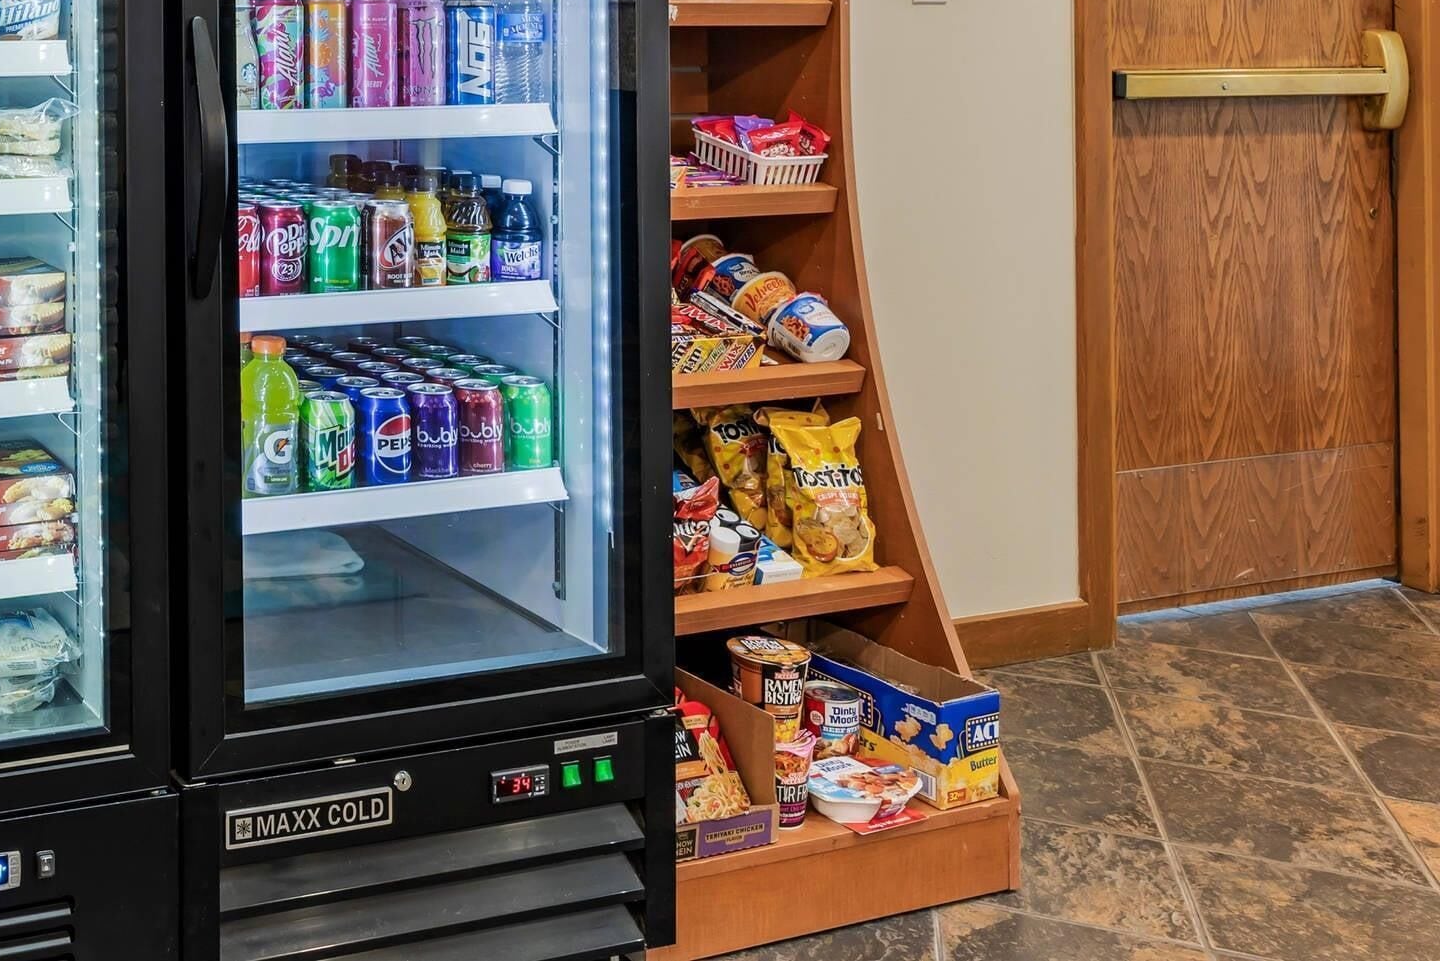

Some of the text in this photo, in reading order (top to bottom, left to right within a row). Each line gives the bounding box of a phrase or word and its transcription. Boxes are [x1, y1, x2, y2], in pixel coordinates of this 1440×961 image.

[459, 9, 492, 98] NOS
[504, 248, 539, 264] Welch's
[281, 262, 294, 275] 23
[679, 305, 729, 331] TWIX
[416, 425, 459, 446] bubly
[472, 462, 493, 470] cherry
[764, 678, 803, 691] RAMEN
[831, 706, 857, 716] Dinty
[829, 715, 858, 725] Moore
[969, 755, 998, 772] Butter
[511, 777, 531, 794] 34
[256, 797, 386, 838] MAXX COLD
[705, 824, 764, 841] TERIYAKI CHICKEN
